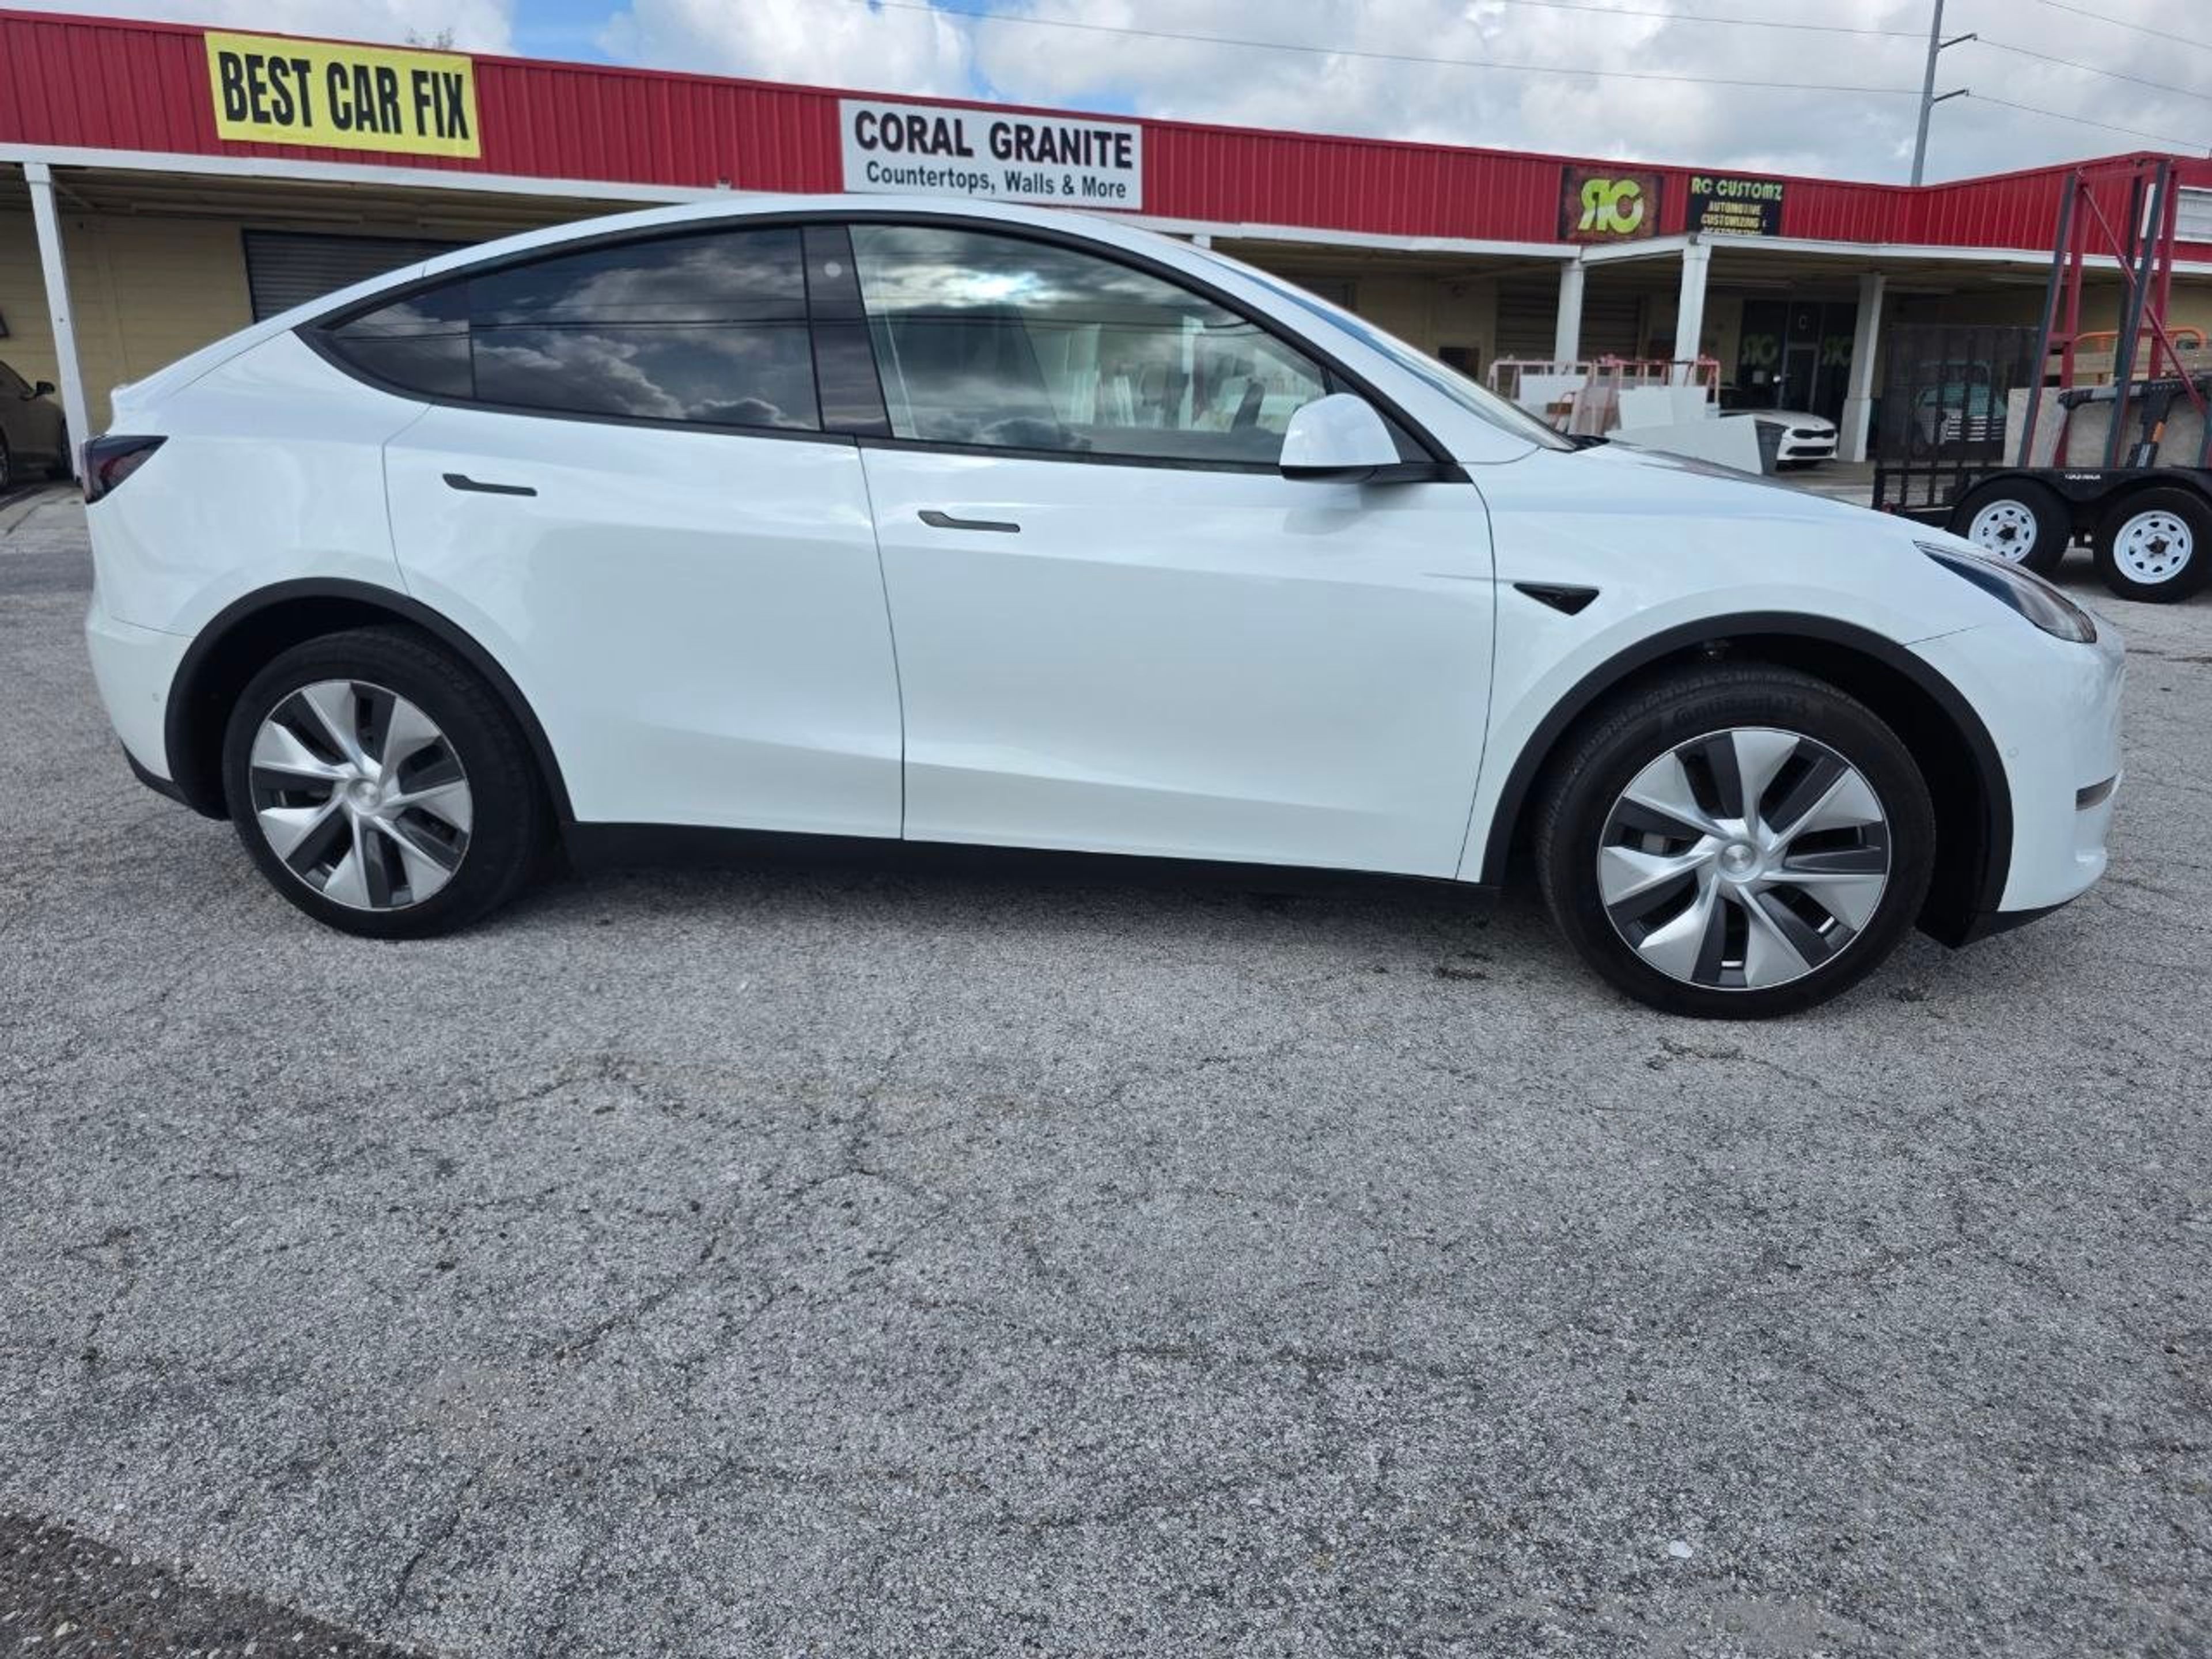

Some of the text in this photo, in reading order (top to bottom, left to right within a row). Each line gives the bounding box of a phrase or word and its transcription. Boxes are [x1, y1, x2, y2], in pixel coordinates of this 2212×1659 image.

[219, 51, 469, 140] BEST CAR FIX
[855, 111, 1132, 168] CORAL GRANITE
[867, 161, 1126, 198] Countertops, Walls & More
[1692, 177, 1783, 201] RC CUSTOMZ
